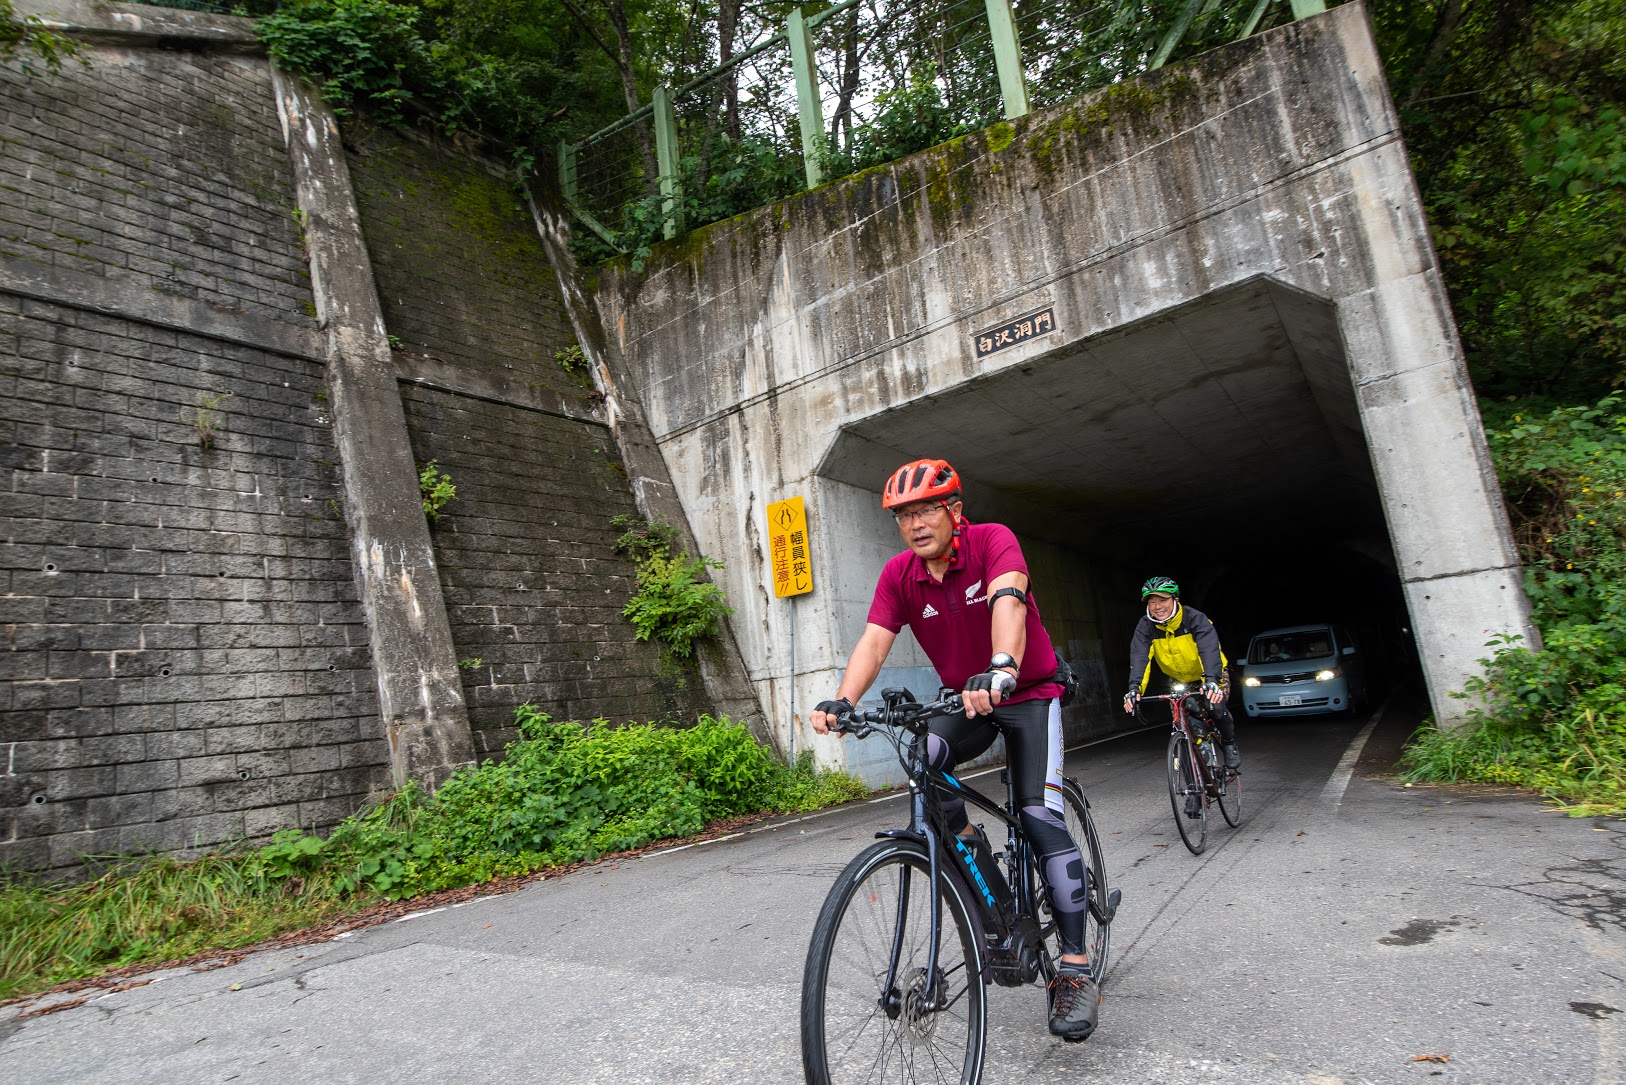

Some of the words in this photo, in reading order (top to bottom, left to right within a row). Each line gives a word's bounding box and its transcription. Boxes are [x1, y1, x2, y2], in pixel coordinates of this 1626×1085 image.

[978, 311, 1052, 353] 白沢洞門
[790, 530, 808, 591] 幅員狭し
[955, 835, 996, 908] TREK
